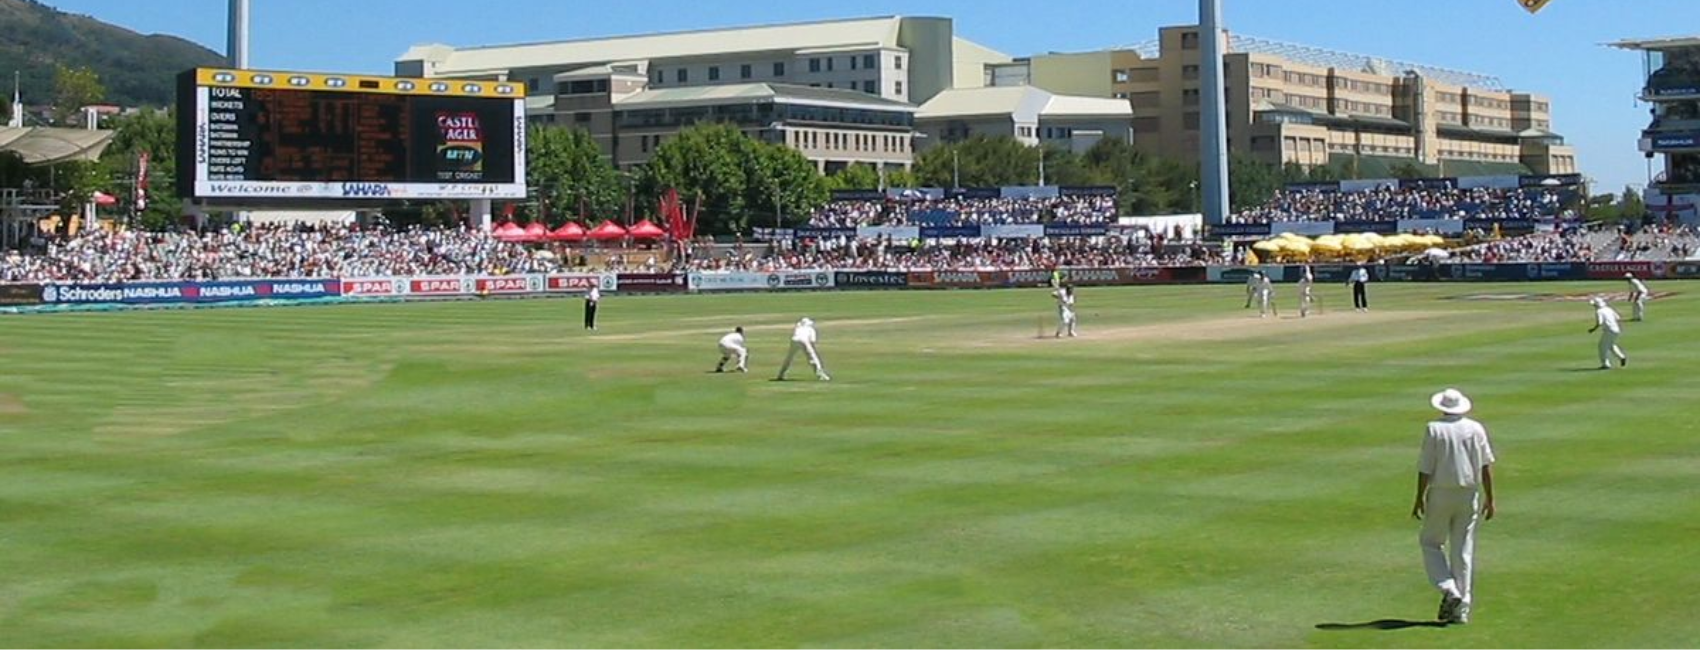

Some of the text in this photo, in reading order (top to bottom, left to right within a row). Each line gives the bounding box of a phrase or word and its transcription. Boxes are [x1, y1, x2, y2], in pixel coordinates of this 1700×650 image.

[211, 87, 242, 98] TOTAL
[210, 183, 291, 195] Welcome
[342, 182, 391, 196] SAHARA
[849, 274, 906, 285] Investec
[933, 271, 980, 283] SAHARA
[1071, 269, 1118, 281] SAHARA
[273, 282, 325, 294] NASHUA
[353, 281, 392, 294] SPAR
[420, 279, 460, 292] SPAR
[485, 278, 526, 290] SPAR
[59, 285, 123, 301] Schroders
[124, 286, 181, 298] NASHUA
[200, 285, 255, 297] NASHUA
